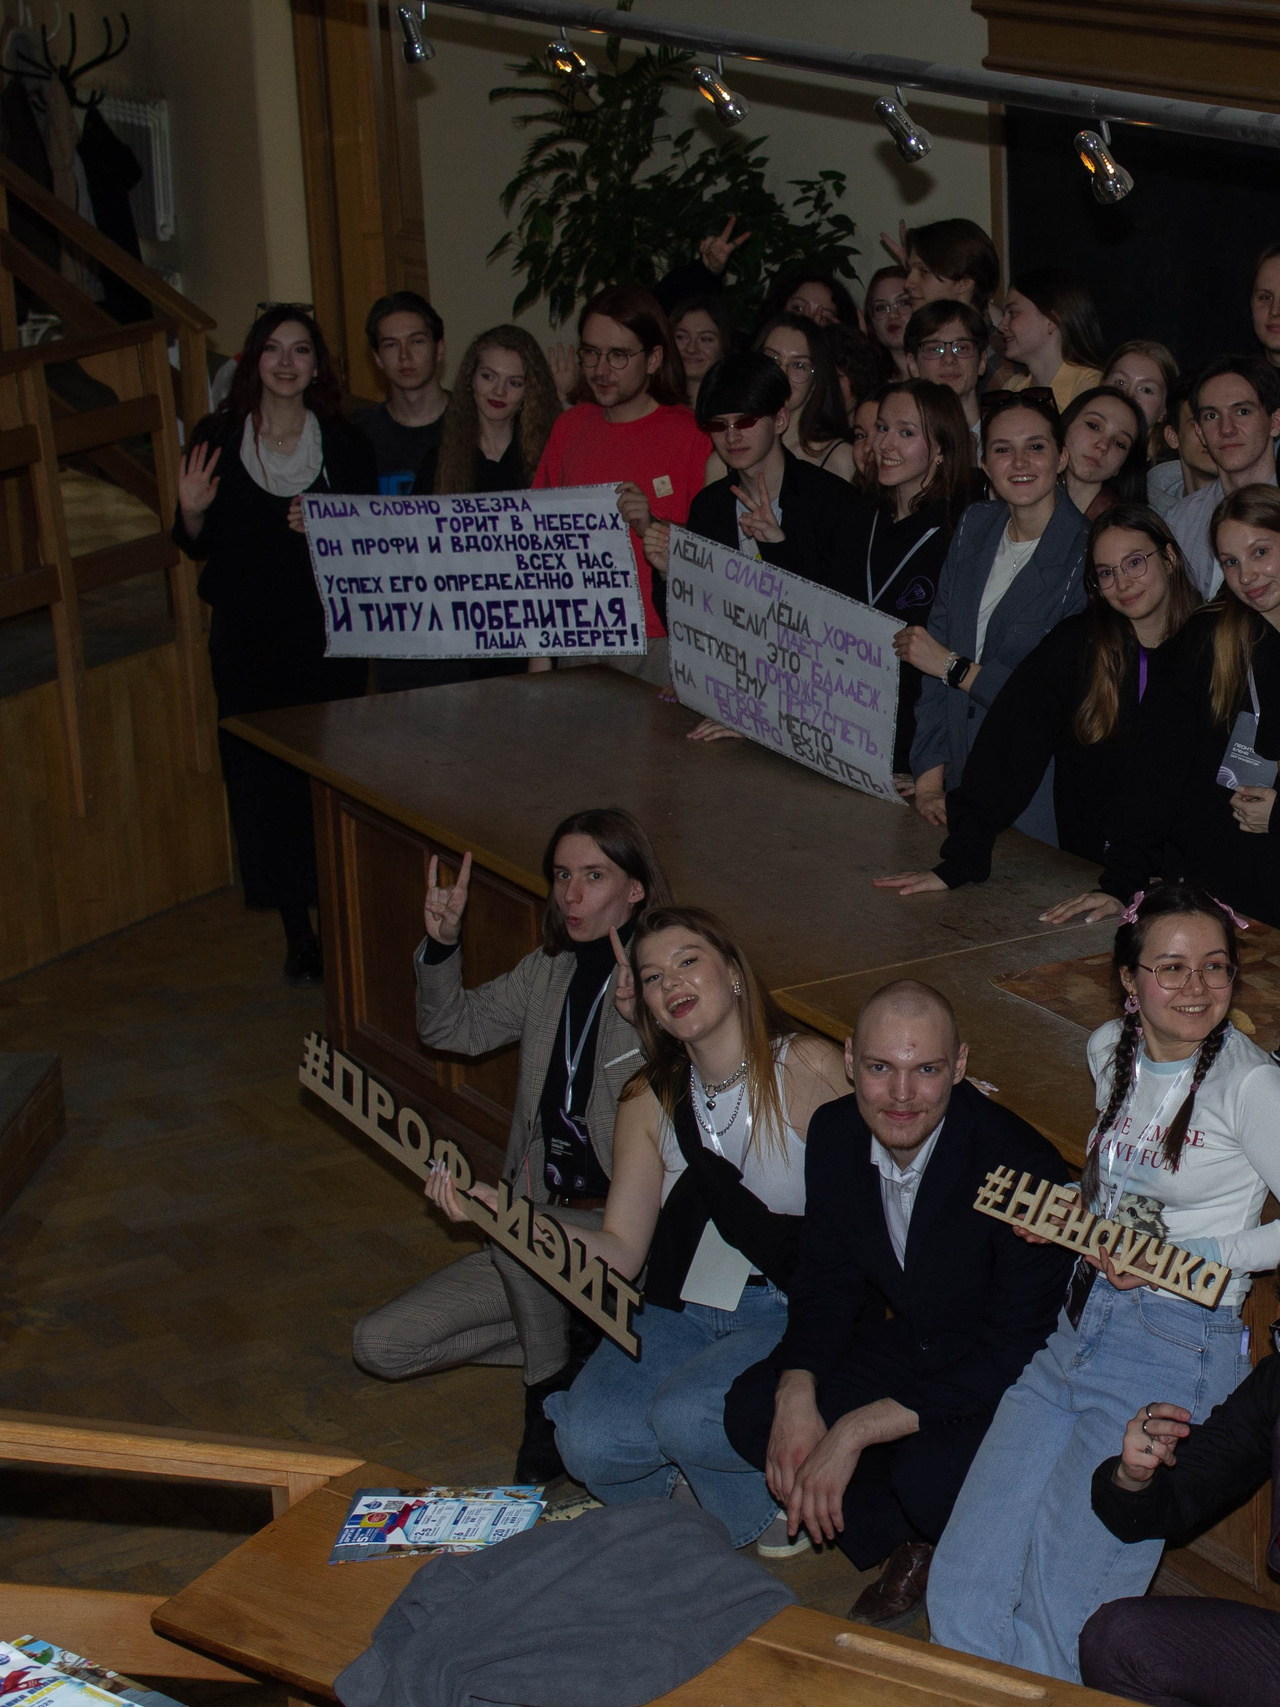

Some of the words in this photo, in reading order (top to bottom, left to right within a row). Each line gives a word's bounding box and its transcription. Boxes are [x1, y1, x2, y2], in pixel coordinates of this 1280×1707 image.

[308, 500, 360, 519] ПАША
[369, 499, 441, 516] СЛОВНО
[451, 497, 532, 514] ЗВЕЗДА
[435, 514, 499, 534] ГОРИТ
[510, 515, 523, 532] В
[316, 538, 343, 557] ОН
[351, 537, 419, 555] ПРОФИ
[428, 536, 442, 554] И
[450, 533, 590, 553] ВДОХНОВЛЯЕТ
[673, 536, 714, 573] ЛЁША
[516, 553, 567, 571] ВСЕХ
[324, 575, 384, 594] УСПЕХ
[389, 575, 427, 593] ЕГО
[328, 596, 352, 632] И
[358, 602, 444, 632] ТИТУЛ
[451, 597, 627, 631] ПОБЕДИТЕЛЯ
[672, 577, 693, 606] ОН
[702, 589, 714, 616] К
[723, 599, 767, 640] ЦЕЛИ
[767, 600, 811, 638] ЛЁША
[476, 631, 526, 650] ПАША
[672, 620, 747, 674] СТЕТХЕМ
[756, 657, 833, 712] ПОМОЖЕТ
[767, 641, 800, 674] ЭТО
[736, 668, 768, 700] ЕМУ
[674, 659, 697, 689] НА
[778, 709, 833, 754] МЕСТО
